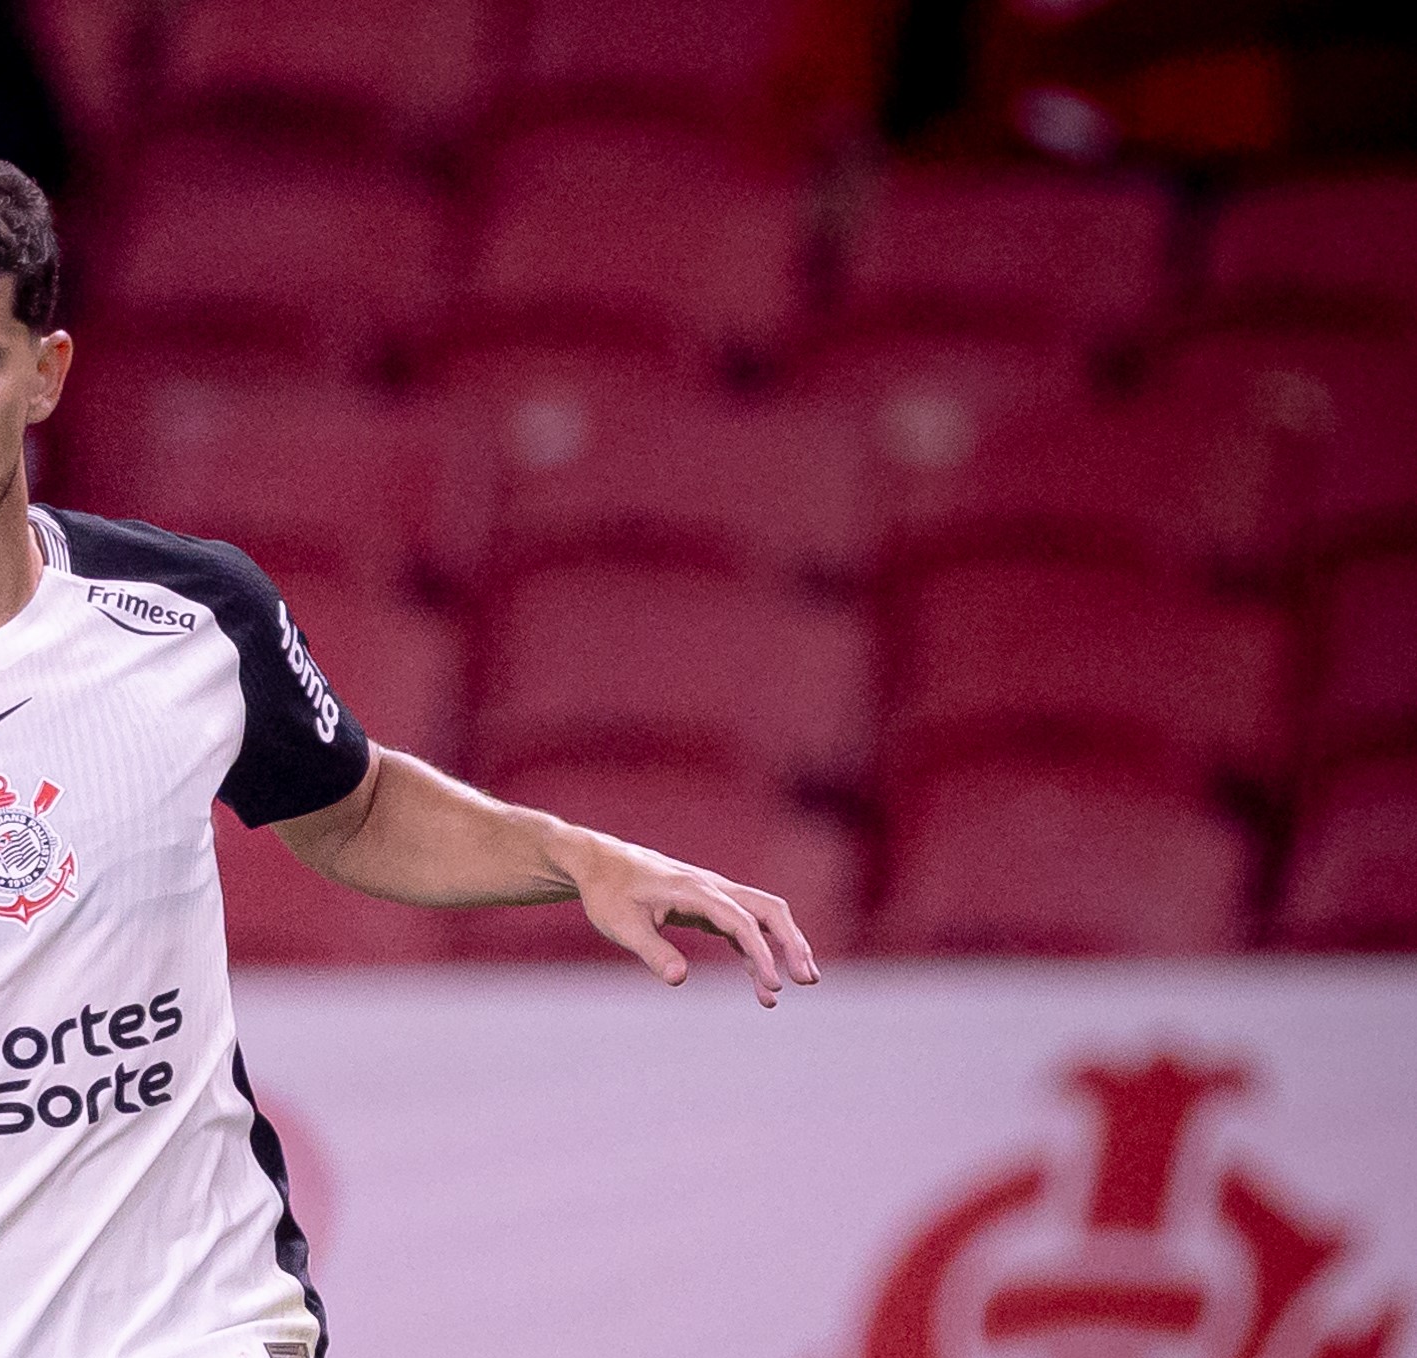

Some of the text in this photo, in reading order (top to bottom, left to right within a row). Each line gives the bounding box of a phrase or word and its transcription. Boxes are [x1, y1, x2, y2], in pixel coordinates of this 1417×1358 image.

[86, 585, 197, 632] Frimesa
[27, 819, 50, 869] PAULISTA
[7, 875, 33, 888] 1910
